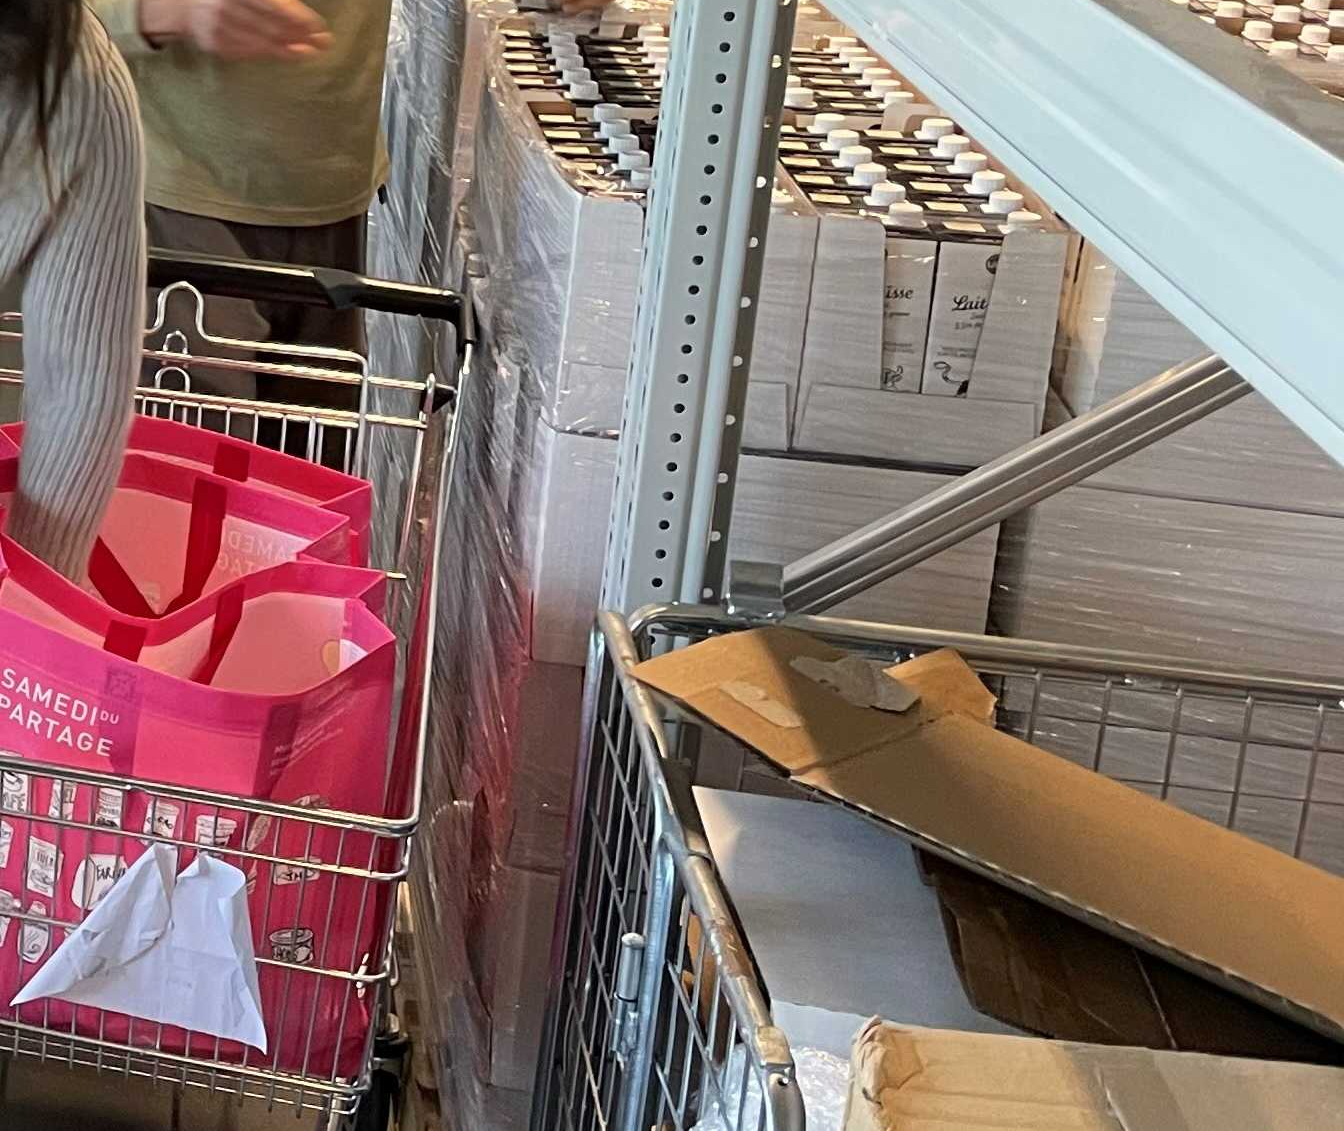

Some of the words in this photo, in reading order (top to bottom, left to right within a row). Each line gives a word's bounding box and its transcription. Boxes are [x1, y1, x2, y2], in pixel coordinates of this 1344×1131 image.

[885, 284, 914, 300] isse
[1, 668, 98, 726] SAMEDI
[100, 710, 119, 725] DU
